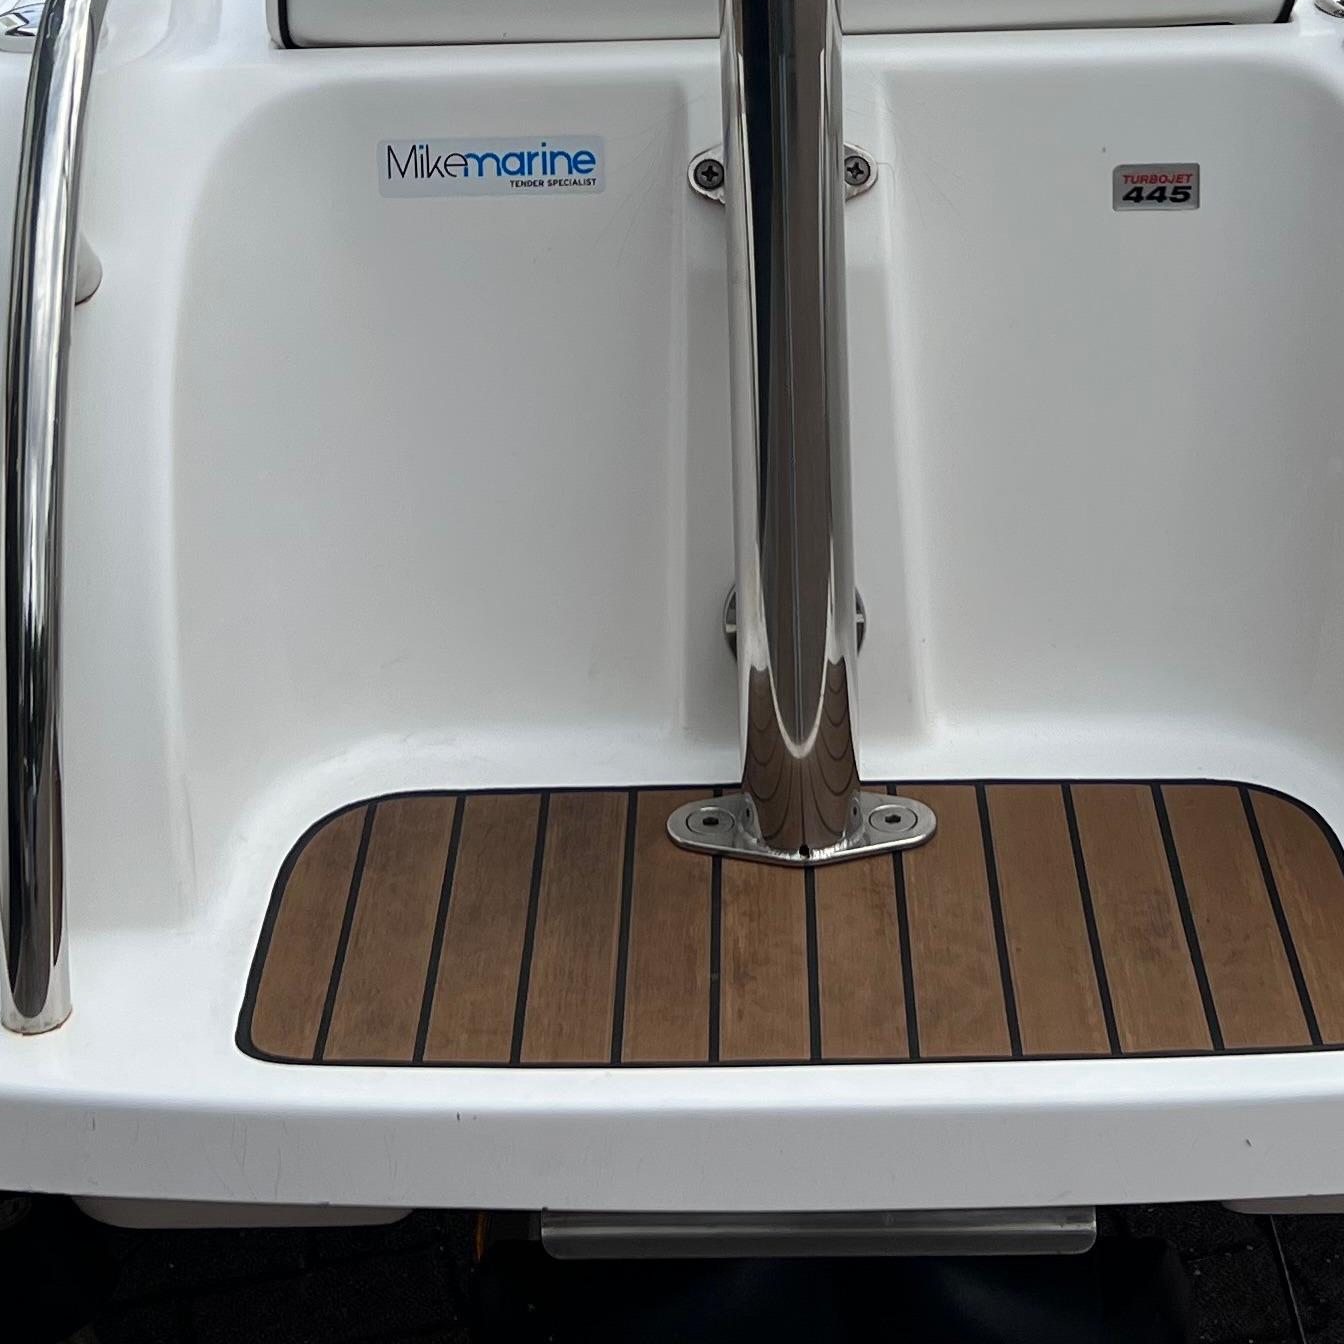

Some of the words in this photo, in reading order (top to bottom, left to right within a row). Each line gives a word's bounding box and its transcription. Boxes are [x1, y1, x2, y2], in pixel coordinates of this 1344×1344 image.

[387, 142, 596, 179] Mikemarine
[510, 179, 544, 188] TENDER
[547, 178, 597, 187] SPECIALIST
[1122, 173, 1193, 184] TURBOJET
[1122, 185, 1192, 203] 445
